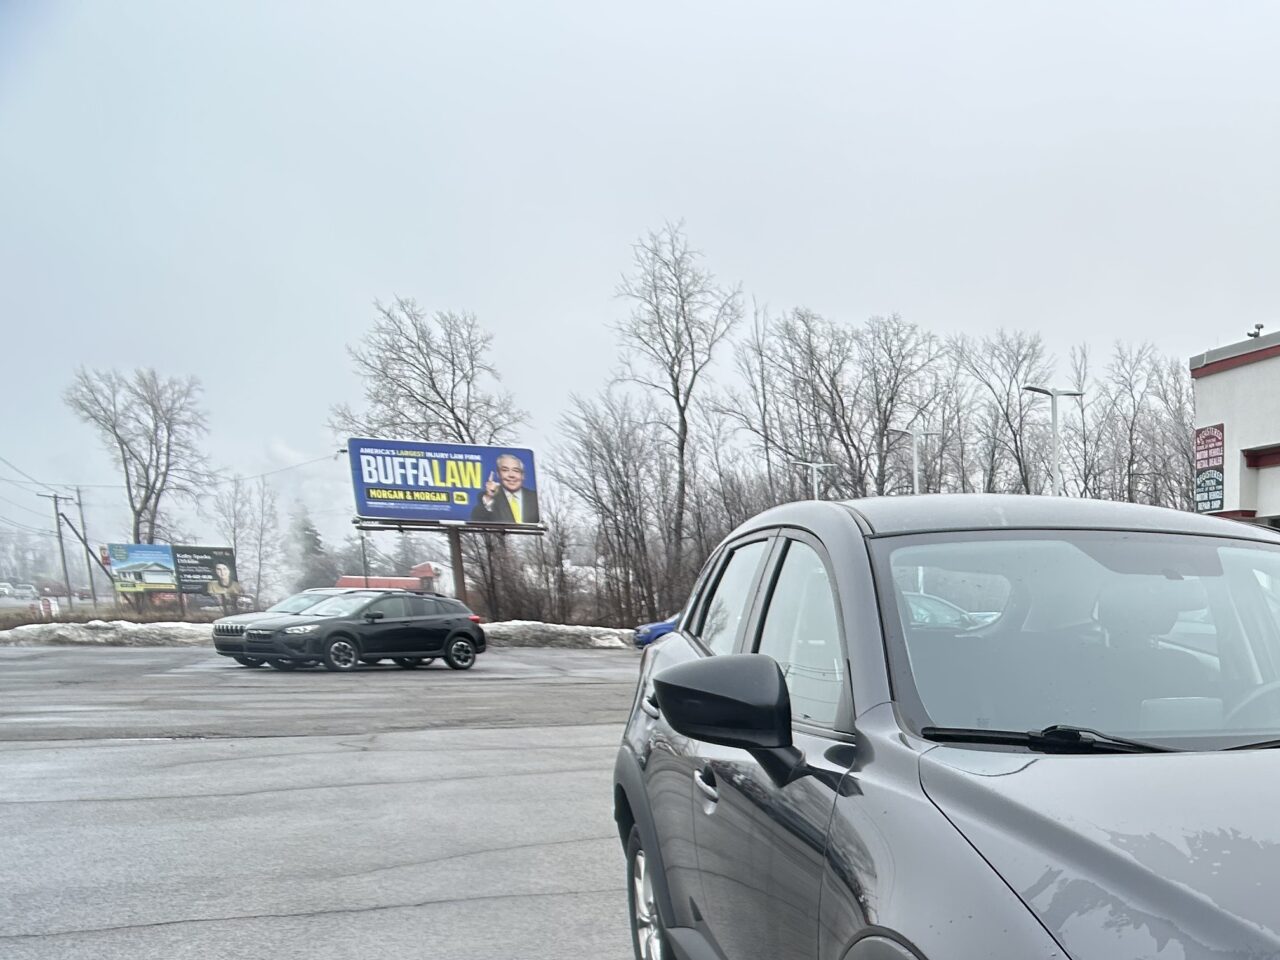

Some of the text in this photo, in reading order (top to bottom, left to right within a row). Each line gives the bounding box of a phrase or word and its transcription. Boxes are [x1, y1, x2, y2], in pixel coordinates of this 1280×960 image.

[425, 451, 449, 459] INJURY
[360, 454, 482, 490] BUFFALAW
[369, 489, 405, 500] MORGAN
[413, 491, 448, 502] MORGAN
